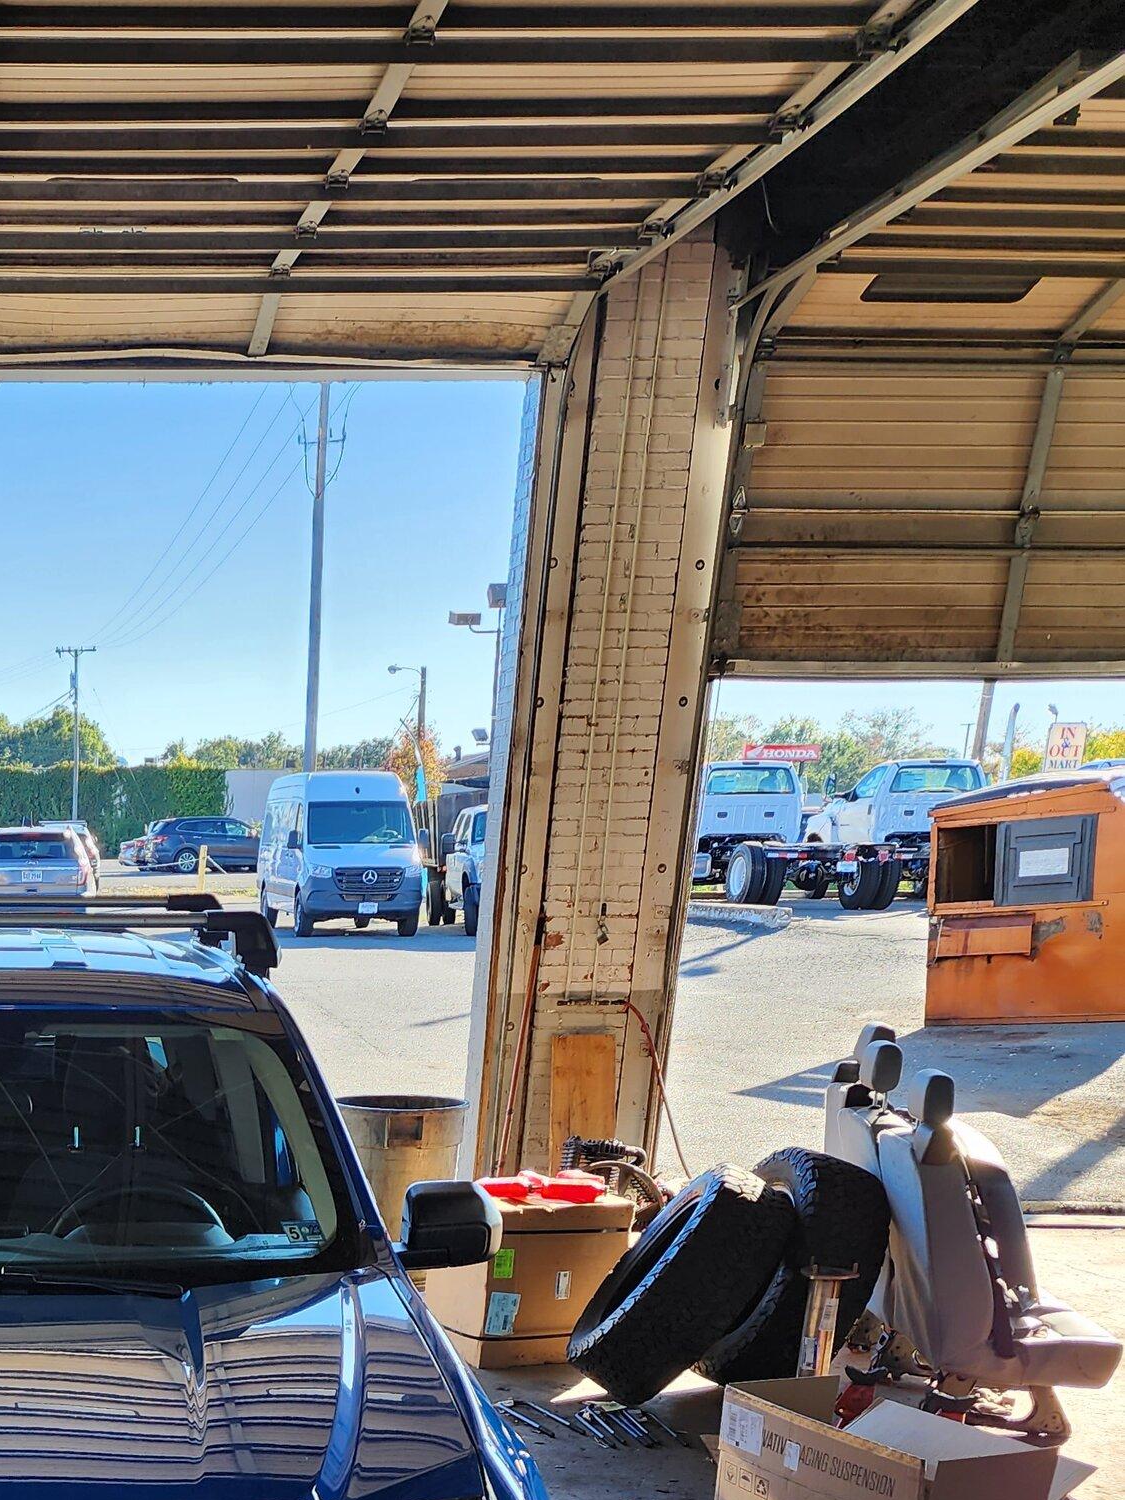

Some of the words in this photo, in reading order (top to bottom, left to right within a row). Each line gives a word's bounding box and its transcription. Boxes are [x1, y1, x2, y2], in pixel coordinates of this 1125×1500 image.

[1059, 726, 1077, 739] IN
[762, 749, 818, 759] HONDA
[1049, 744, 1082, 757] OUT
[288, 1226, 301, 1240] 5
[798, 1443, 829, 1472] ACING
[832, 1456, 896, 1498] SUSPENSION
